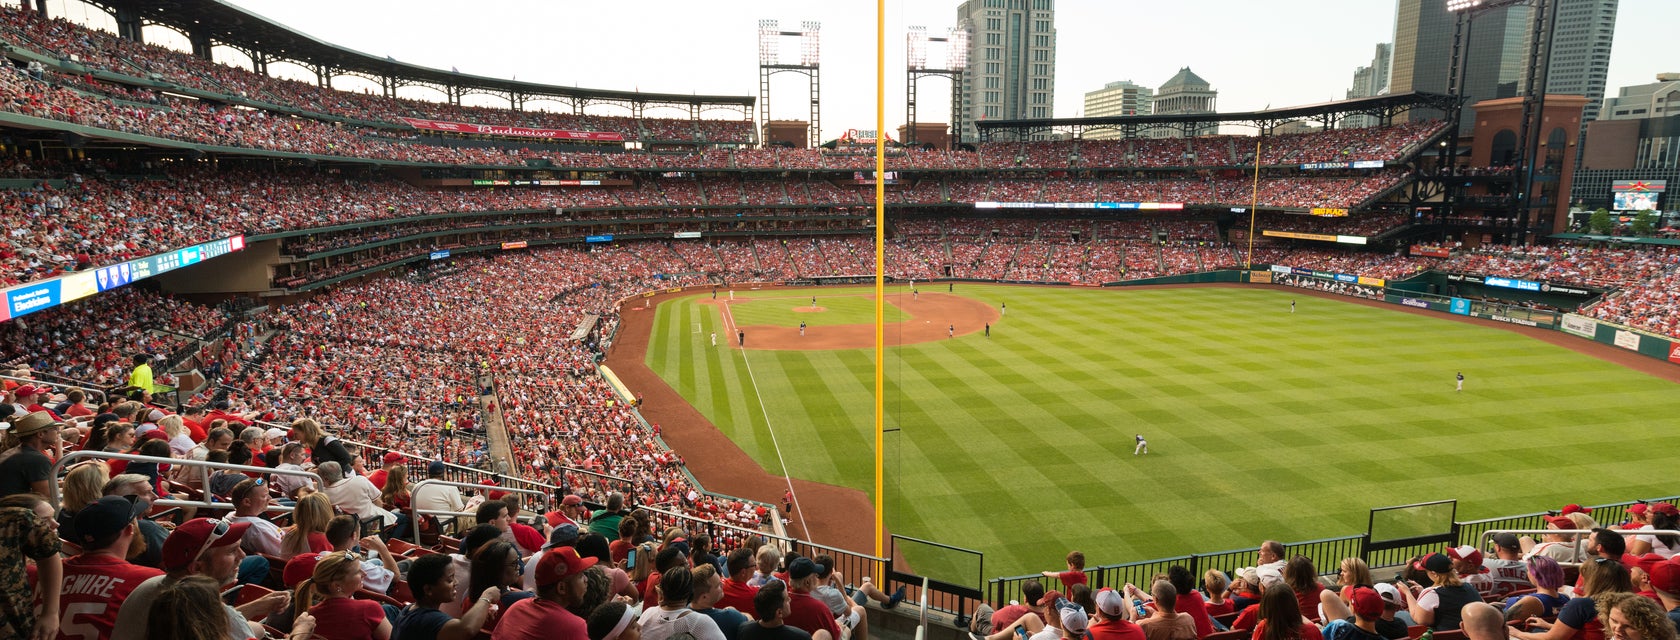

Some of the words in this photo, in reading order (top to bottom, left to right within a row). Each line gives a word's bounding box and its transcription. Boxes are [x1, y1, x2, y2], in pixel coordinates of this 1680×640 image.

[477, 125, 556, 138] Budweiser
[1325, 208, 1344, 216] MAC
[1491, 314, 1511, 322] BUSCH
[1511, 317, 1537, 327] STADIUM
